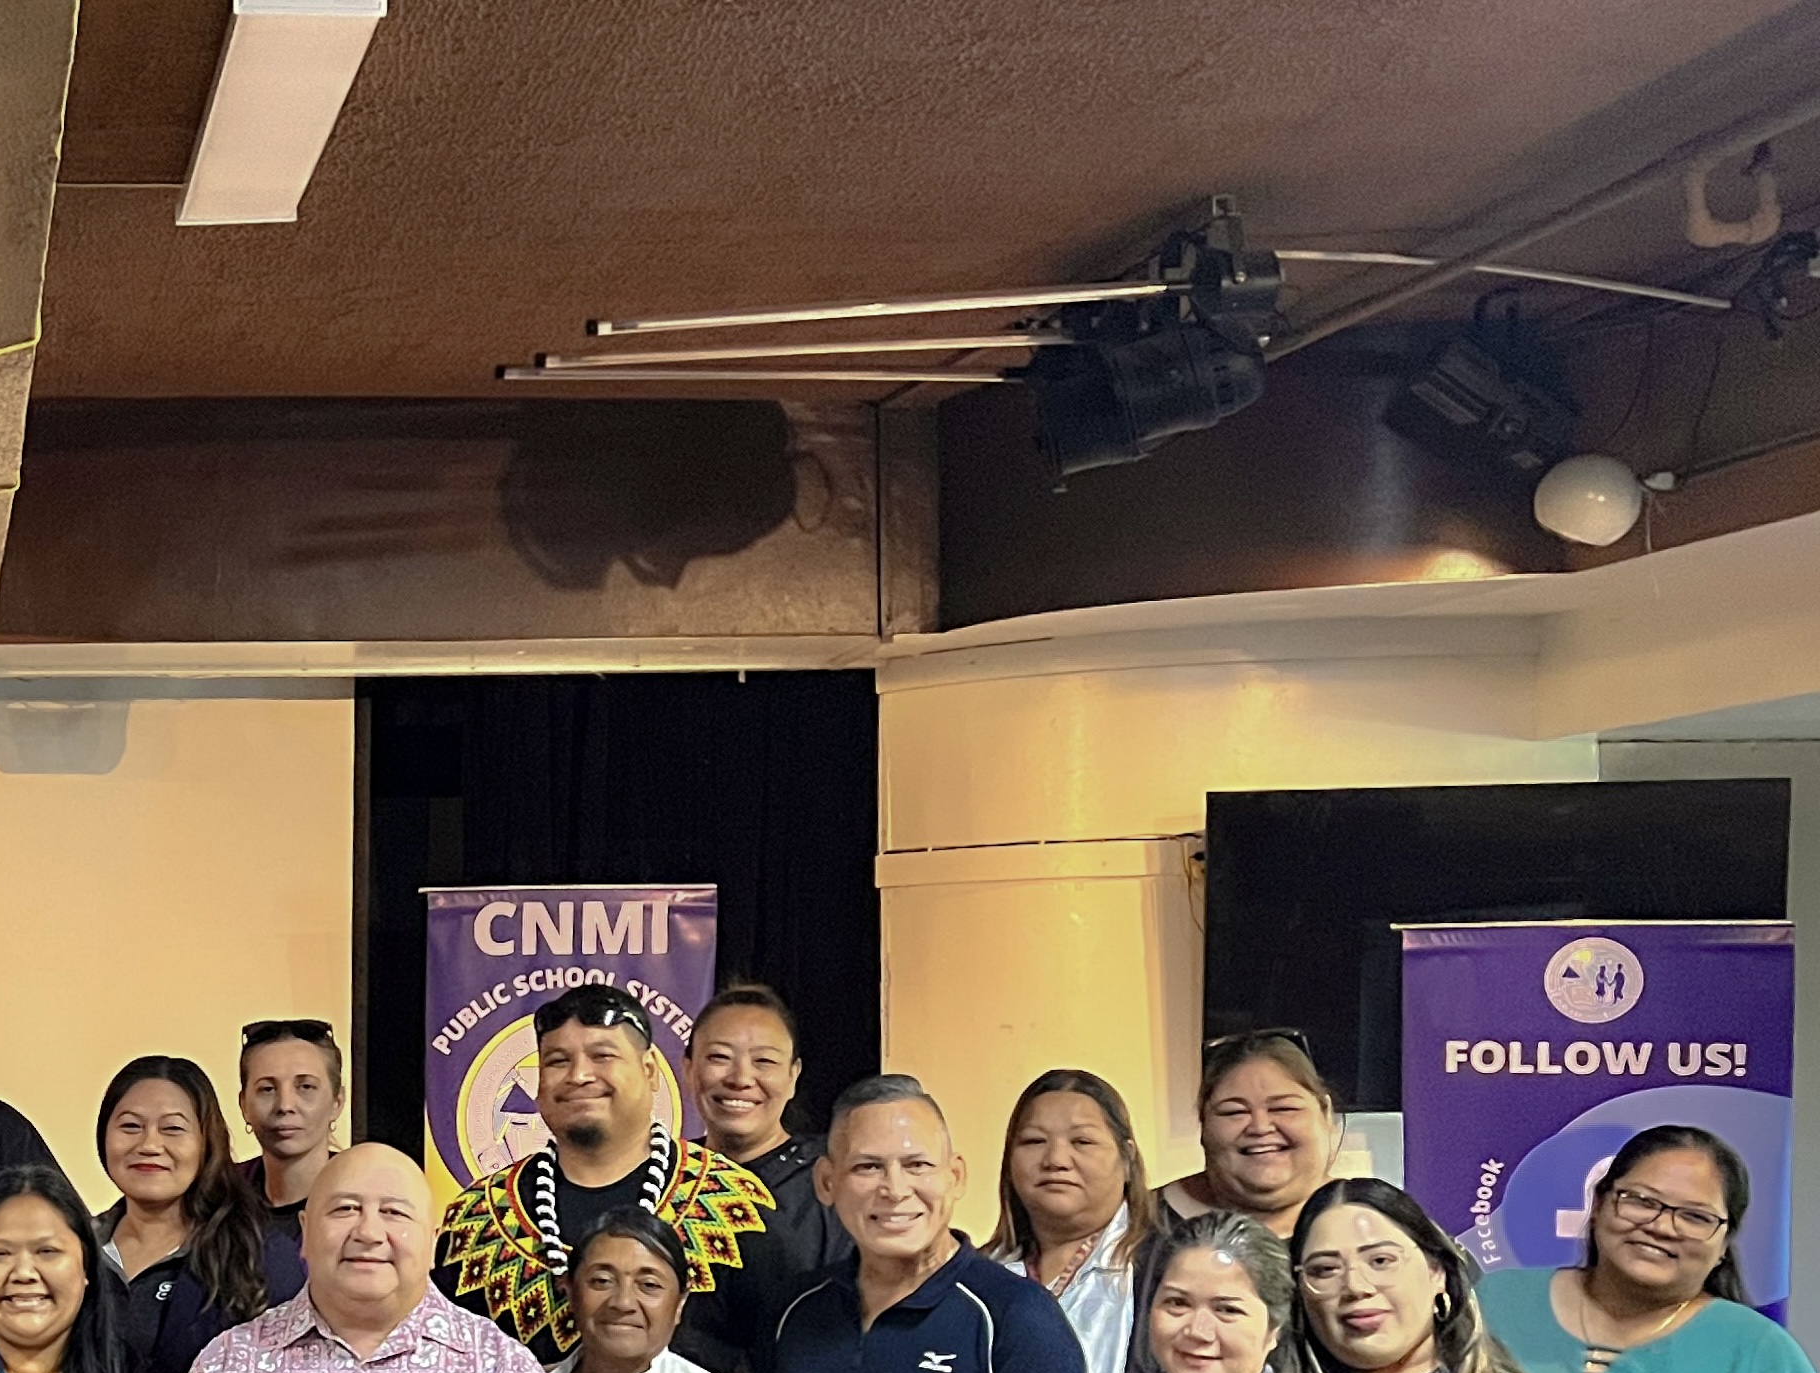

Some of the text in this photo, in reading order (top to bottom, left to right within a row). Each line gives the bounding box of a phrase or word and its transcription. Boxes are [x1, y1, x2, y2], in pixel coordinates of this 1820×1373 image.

[473, 900, 670, 957] CNMI
[431, 982, 512, 1056] PUBLIC
[1444, 1039, 1747, 1077] FOLLOW US!
[1470, 1158, 1505, 1265] Facebook
